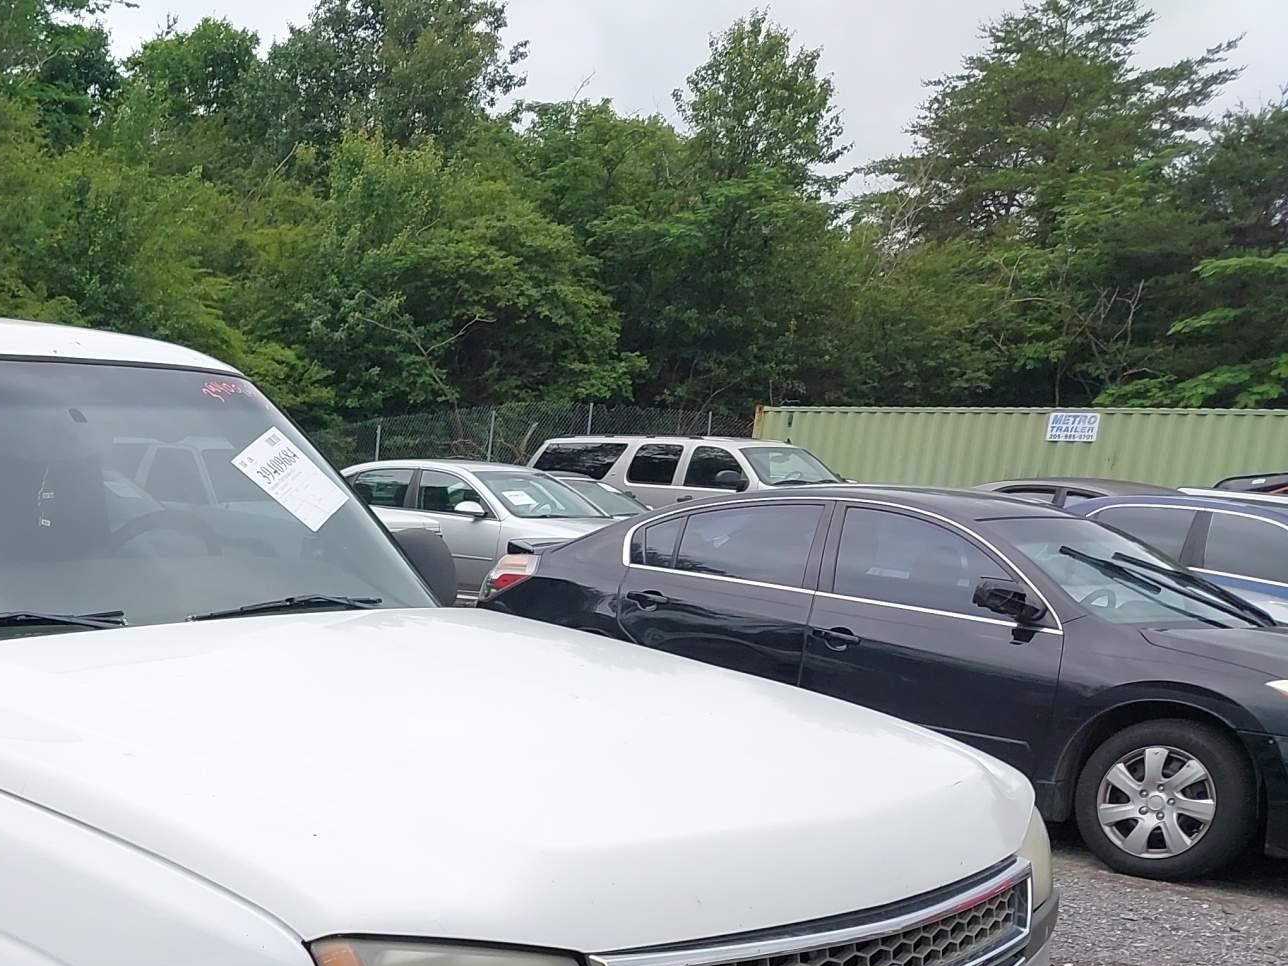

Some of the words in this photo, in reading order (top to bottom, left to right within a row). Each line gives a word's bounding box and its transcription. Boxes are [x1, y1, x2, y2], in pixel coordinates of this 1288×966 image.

[1052, 414, 1098, 425] METRO
[1050, 425, 1096, 433] TRAILER
[256, 446, 300, 485] 39409684
